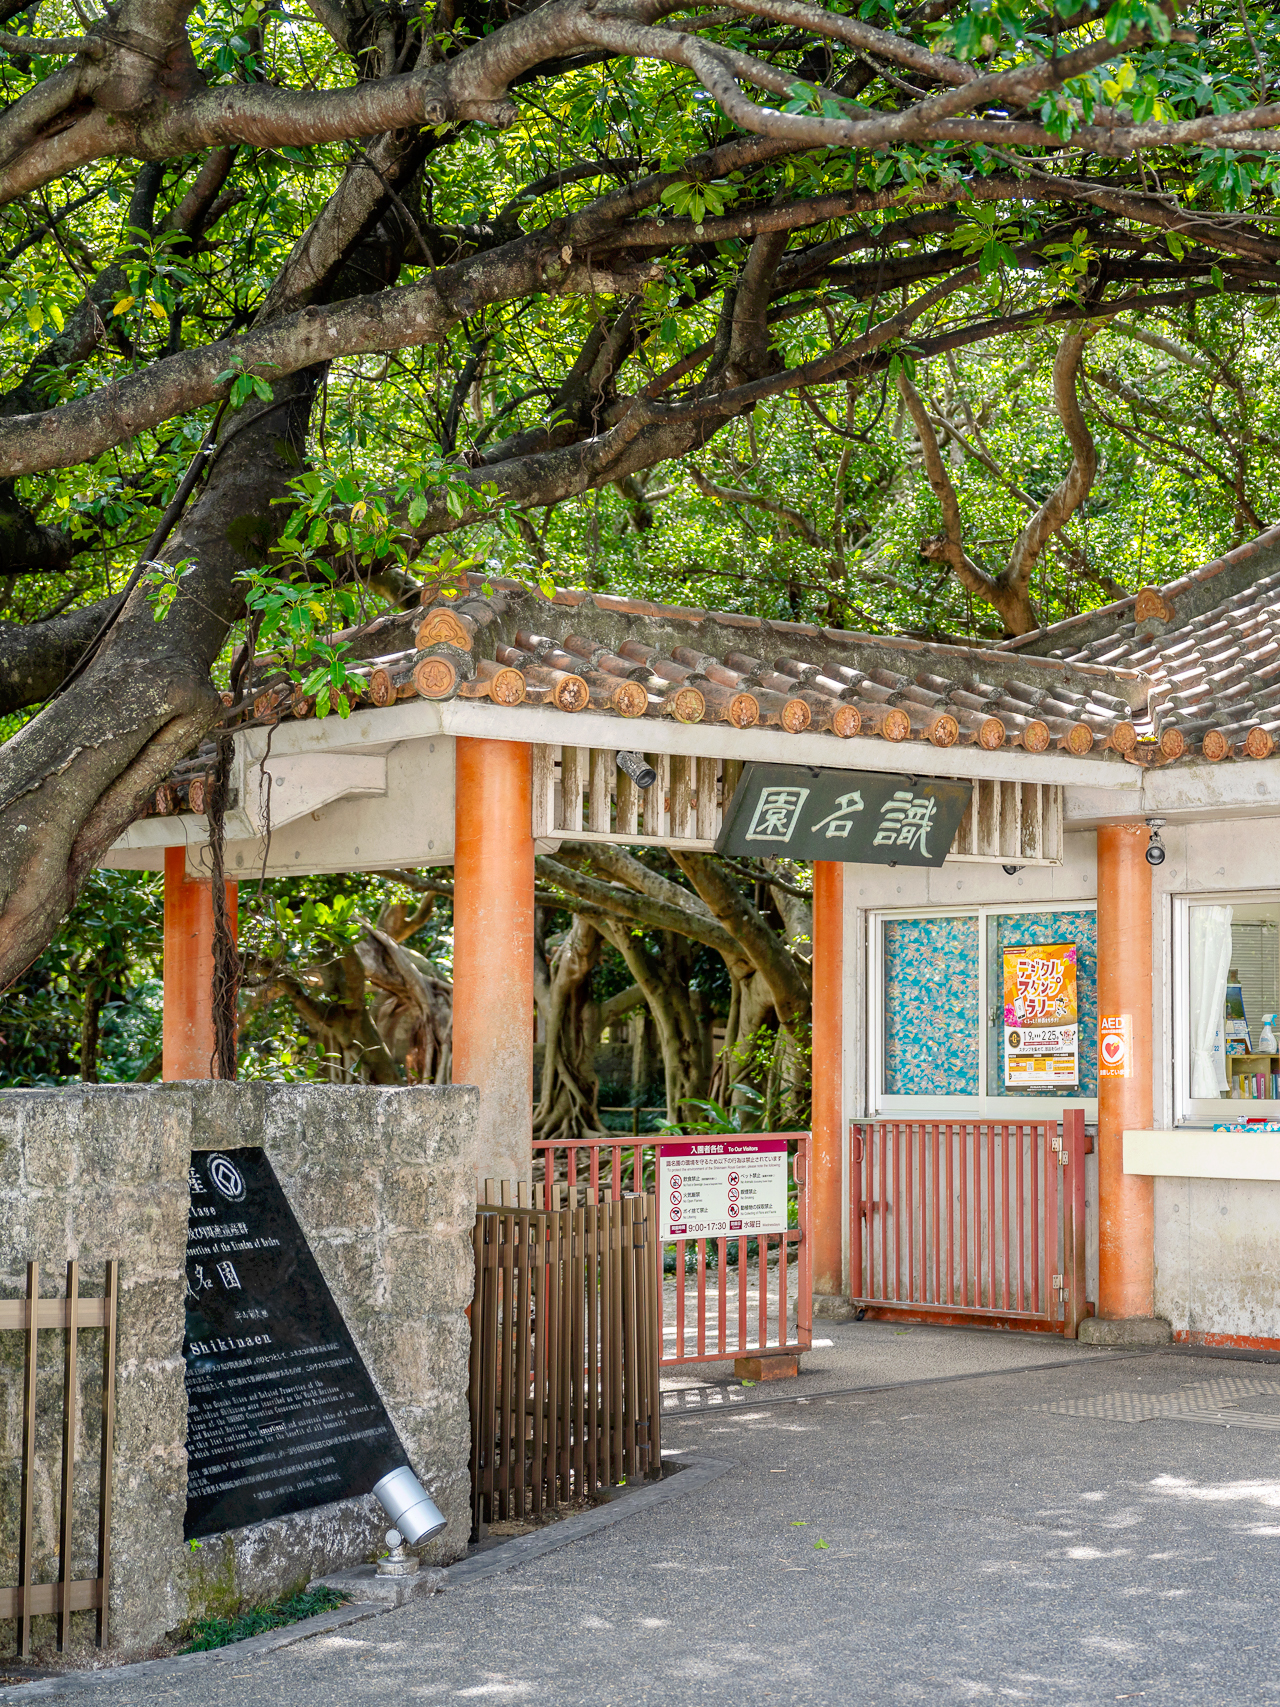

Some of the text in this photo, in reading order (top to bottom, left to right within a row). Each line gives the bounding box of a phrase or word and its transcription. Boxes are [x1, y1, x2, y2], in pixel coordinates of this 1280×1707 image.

[1018, 960, 1063, 979] デジタル
[1018, 976, 1062, 995] スタンプ
[1026, 998, 1054, 1016] ラリー
[1102, 1018, 1124, 1029] AED
[691, 1145, 724, 1154] 入園者各位
[688, 1222, 726, 1232] 9:00-17:30
[220, 1242, 230, 1252] the
[189, 1334, 272, 1356] Shikinaen
